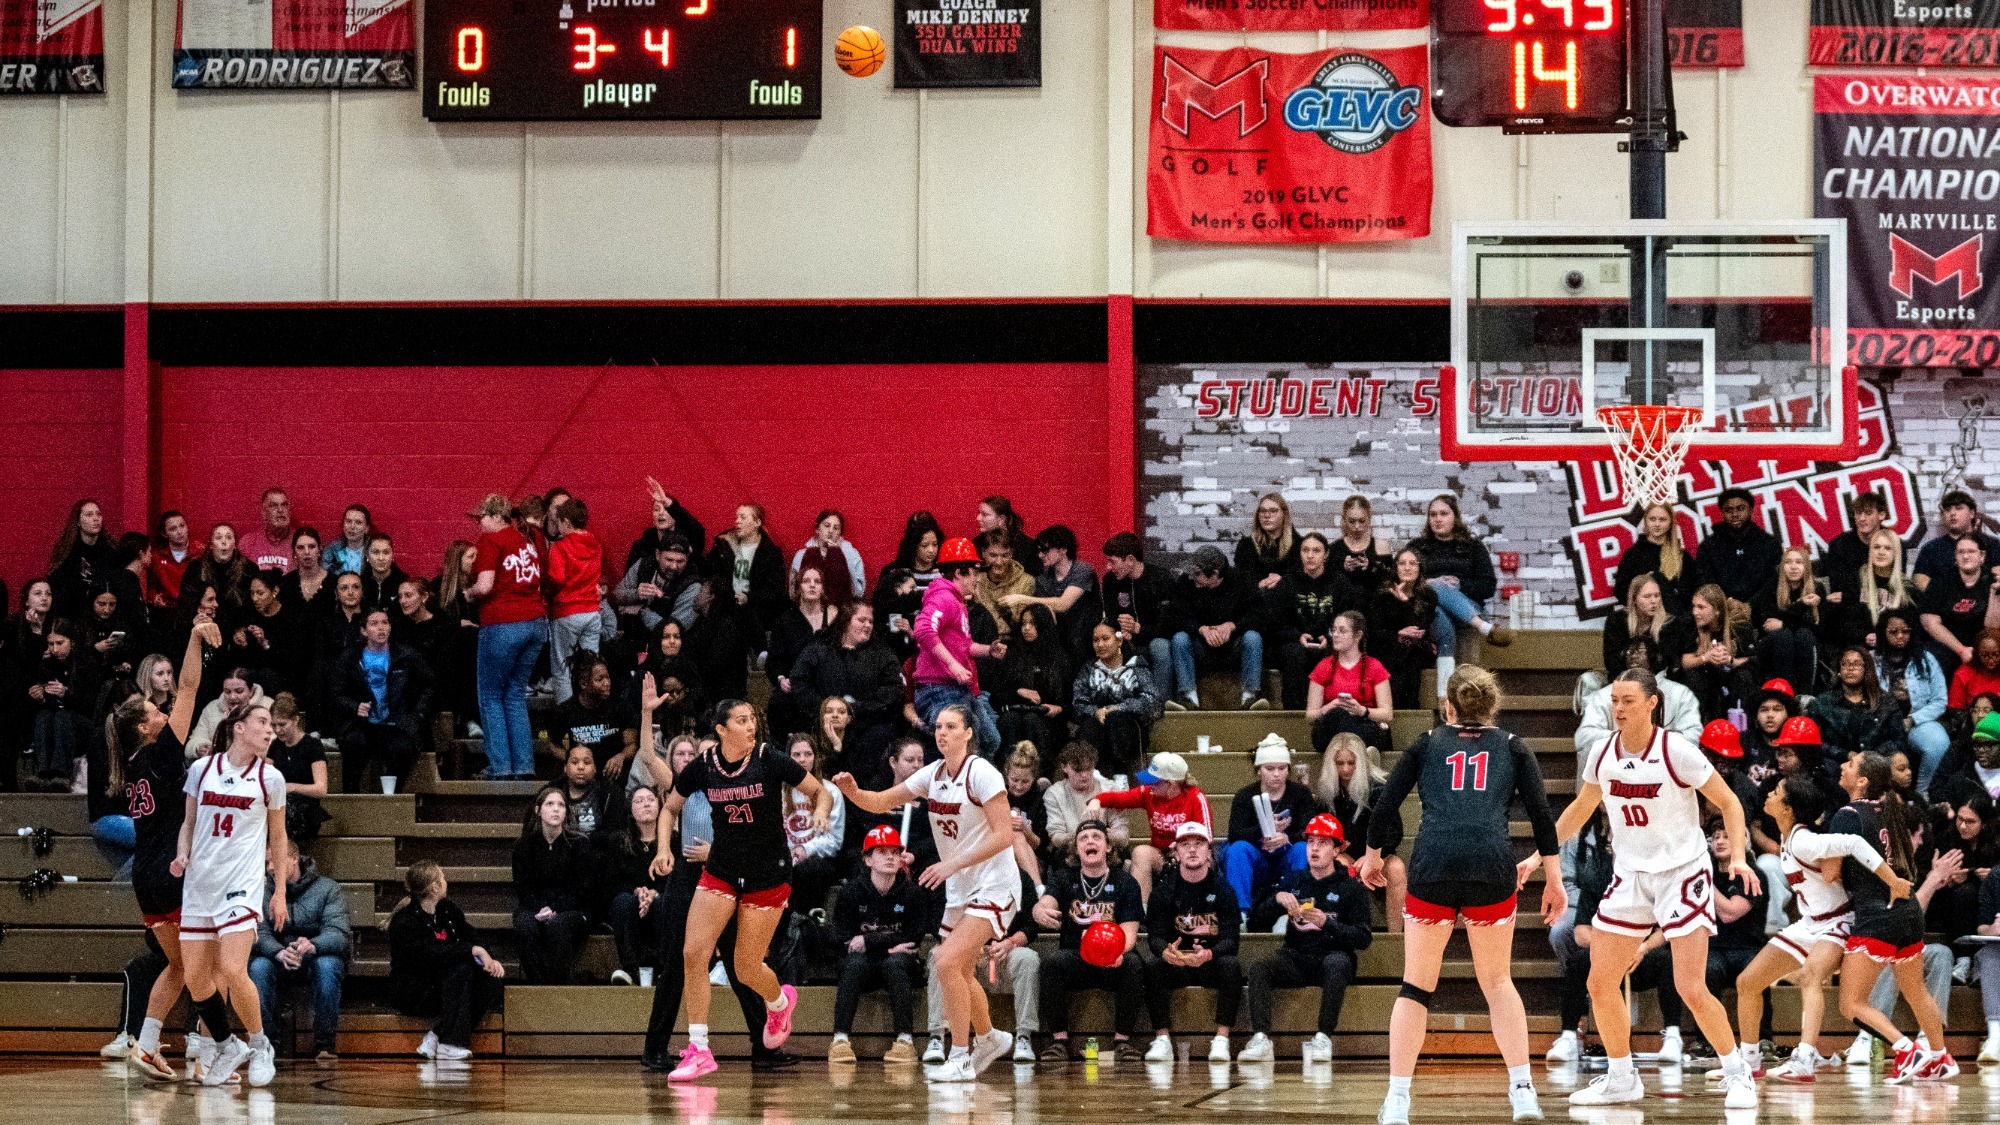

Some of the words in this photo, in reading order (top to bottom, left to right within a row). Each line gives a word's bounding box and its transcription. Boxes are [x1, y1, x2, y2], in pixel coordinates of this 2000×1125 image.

[907, 10, 953, 24] MIKE
[958, 9, 1030, 24] DENNEY
[1187, 0, 1239, 10] Mens
[1893, 0, 1972, 21] Esports
[915, 24, 946, 38] 350
[951, 23, 1021, 38] CAREER
[458, 27, 483, 71] 0
[644, 28, 670, 67] 4
[786, 27, 795, 67] 1
[919, 39, 966, 53] DUAL
[971, 39, 1017, 53] WINS
[0, 63, 37, 89] ER
[203, 58, 381, 83] RODRIGUEZ
[1514, 40, 1577, 110] 14
[438, 82, 491, 106] fouls
[583, 79, 657, 107] player
[749, 80, 803, 106] fouls
[1283, 86, 1422, 132] GLVC
[1327, 137, 1384, 152] CONFERENCE
[1243, 190, 1285, 204] 2019
[1292, 187, 1349, 204] GLVC
[1822, 167, 2000, 200] CHAMPIO
[1191, 212, 1245, 229] Men's
[1252, 211, 1294, 229] Golf
[1300, 211, 1405, 232] Champions
[1878, 213, 1997, 230] MARYVILLE
[1896, 301, 1976, 324] Esports
[1197, 378, 1387, 417] STUDENT
[1412, 376, 1583, 417] SCTION
[1446, 751, 1489, 790] 11
[125, 778, 156, 819] 23
[708, 783, 764, 802] MARYVILLE
[1608, 778, 1663, 800] DRURY
[211, 812, 234, 838] 14
[724, 803, 754, 824] 21
[1621, 804, 1649, 827] 10
